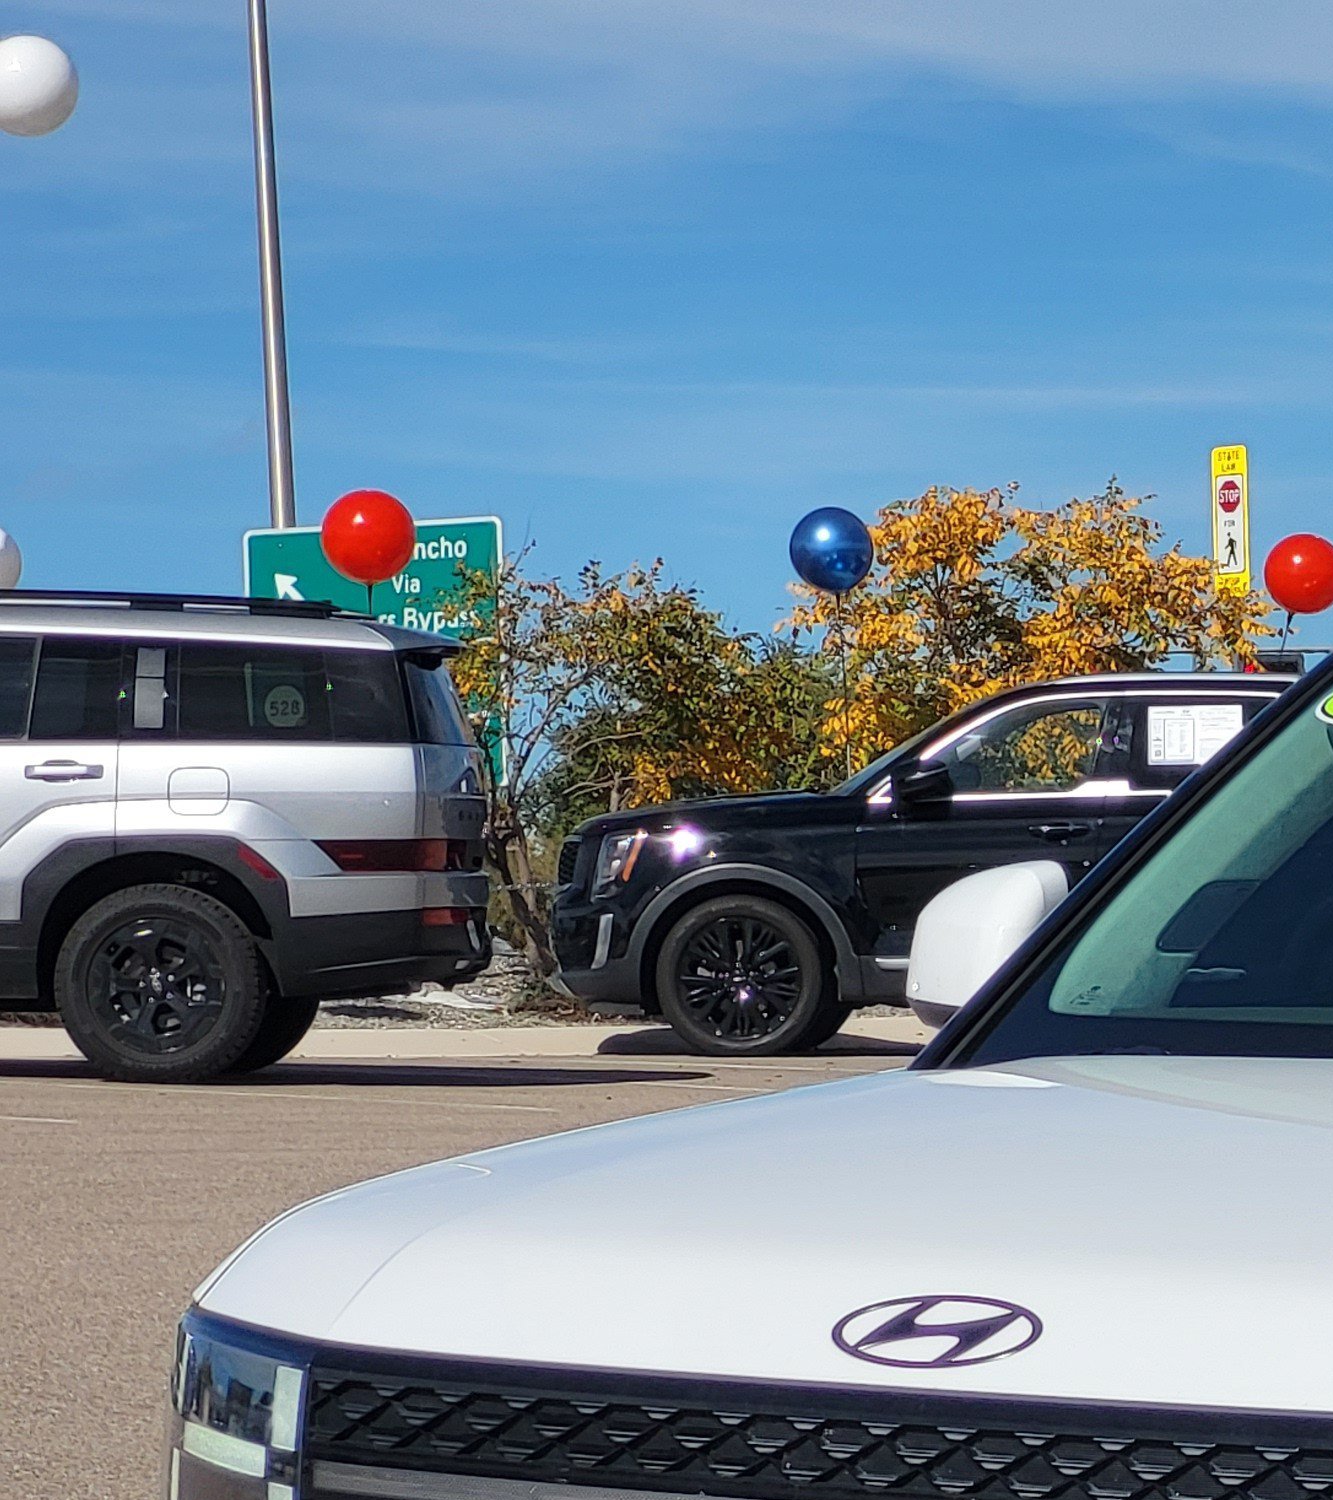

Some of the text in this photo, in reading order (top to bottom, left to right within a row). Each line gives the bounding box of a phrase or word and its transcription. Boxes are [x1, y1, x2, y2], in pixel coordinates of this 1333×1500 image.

[1217, 450, 1239, 461] STATE
[1219, 489, 1240, 504] STOP
[391, 574, 421, 594] Via
[270, 699, 300, 717] 528
